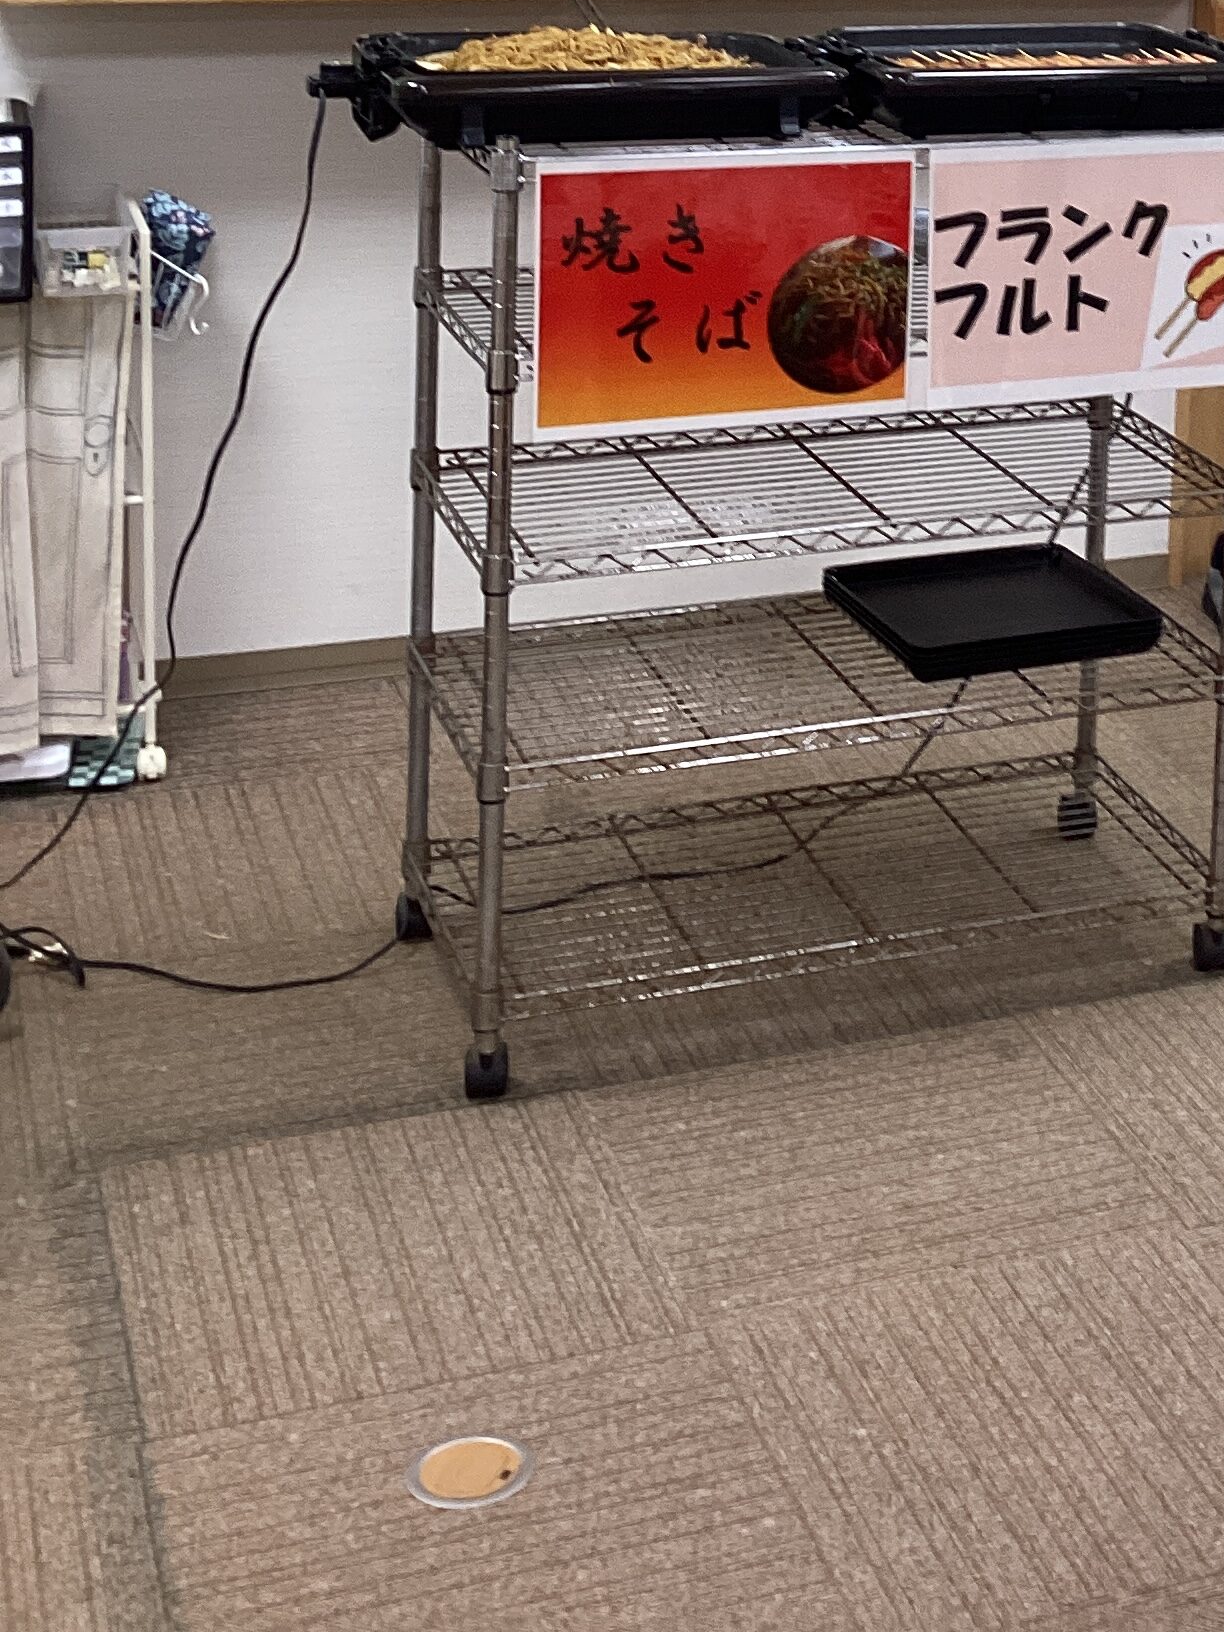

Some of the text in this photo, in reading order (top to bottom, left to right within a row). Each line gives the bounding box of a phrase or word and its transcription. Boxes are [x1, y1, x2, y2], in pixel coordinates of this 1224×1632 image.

[560, 203, 705, 275] 焼き
[933, 199, 1170, 268] フランク
[616, 289, 764, 364] そば
[933, 273, 1109, 342] フルト
